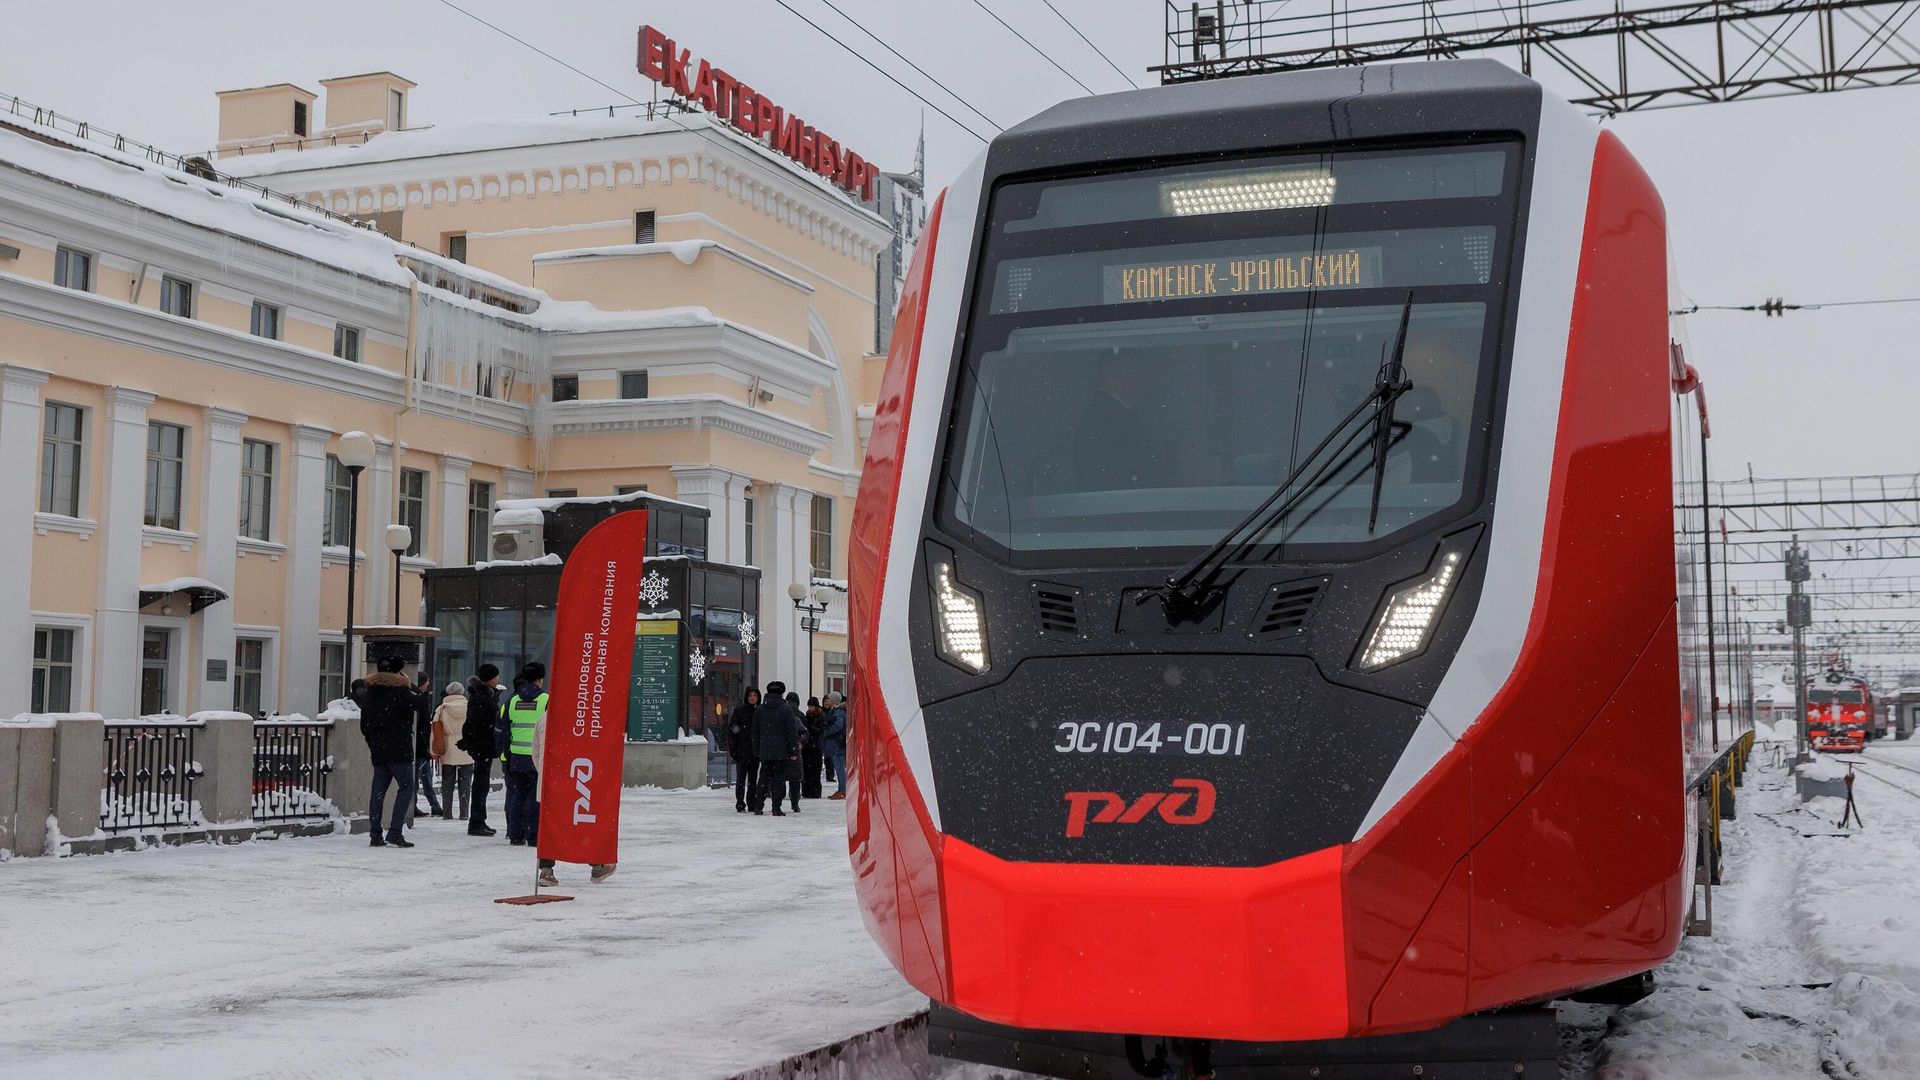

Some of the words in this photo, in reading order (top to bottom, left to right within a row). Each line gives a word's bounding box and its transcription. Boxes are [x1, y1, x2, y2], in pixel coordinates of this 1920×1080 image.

[637, 25, 880, 201] ЕКАТЕРИНБУРГ
[1122, 249, 1360, 300] КАМЕНСК-УРАЛЬСКИЙ
[573, 632, 594, 737] Свердловская
[590, 639, 608, 738] пригородная
[600, 560, 617, 636] компания
[636, 677, 642, 686] 2
[1055, 722, 1246, 755] ЭС104-001
